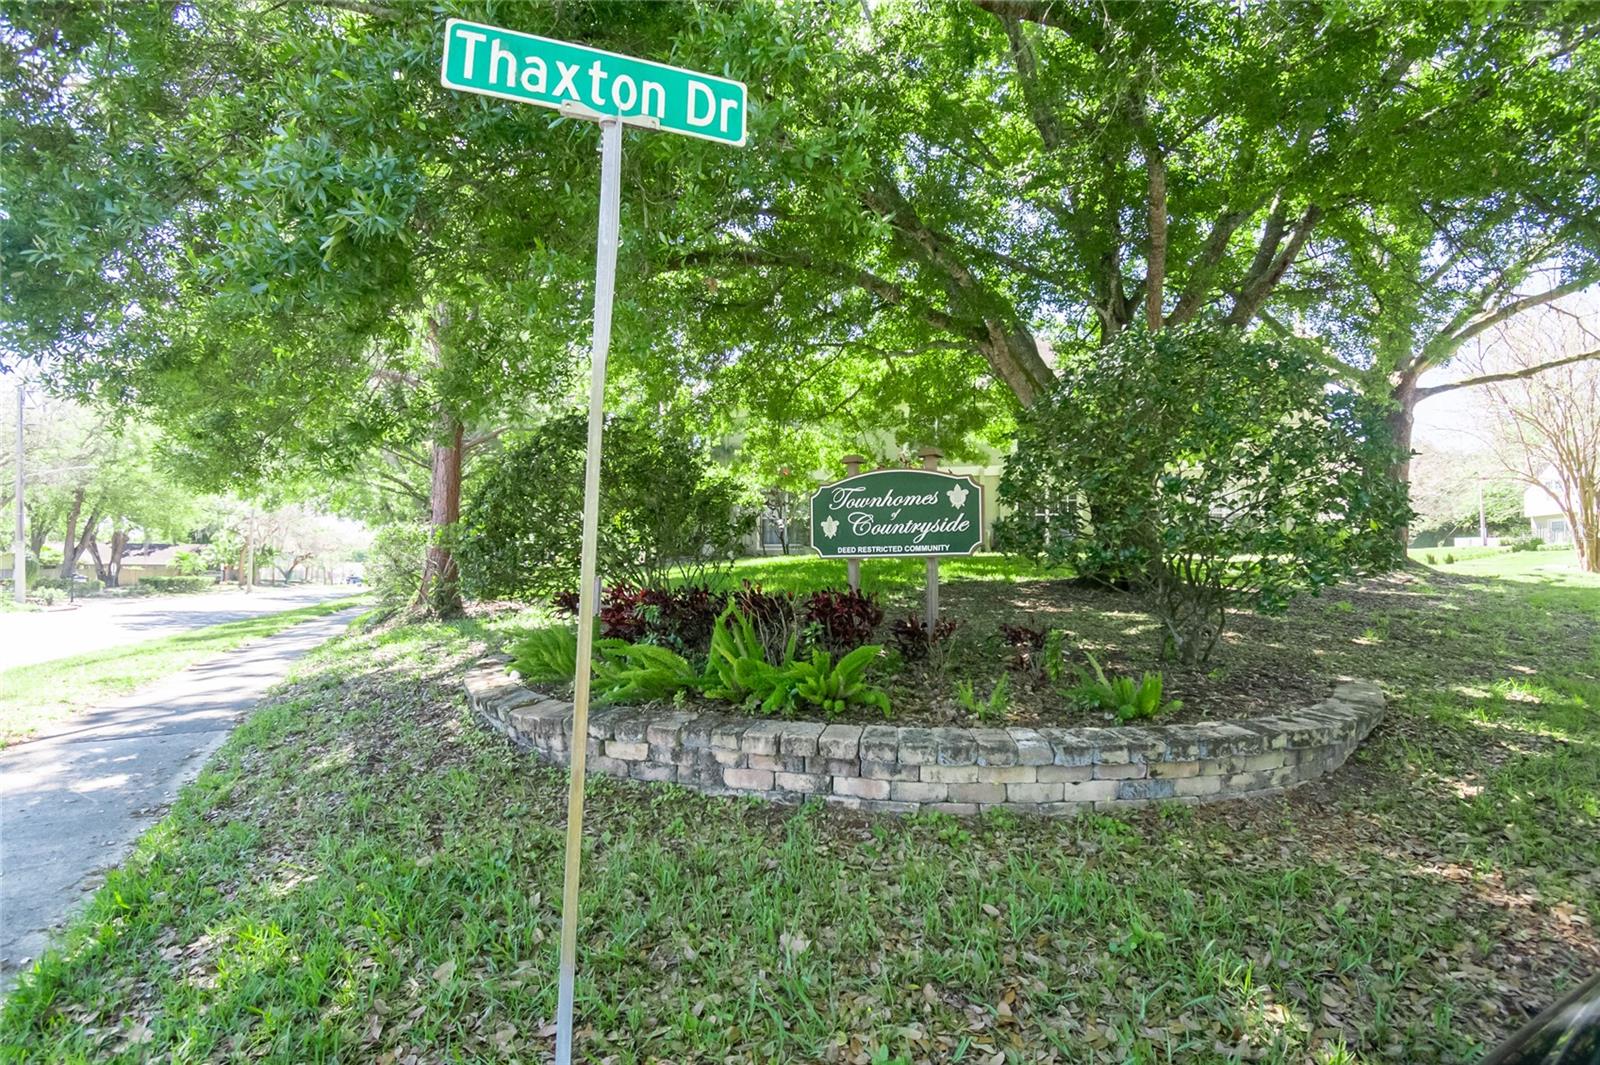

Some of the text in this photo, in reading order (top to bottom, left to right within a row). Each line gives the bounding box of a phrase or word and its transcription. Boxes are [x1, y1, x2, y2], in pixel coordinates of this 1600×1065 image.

[456, 29, 738, 133] Thaxton Dr
[829, 487, 939, 510] Townhomes
[890, 508, 902, 521] of
[848, 512, 970, 543] Countryside
[837, 544, 951, 554] DEED RESTRICTED COMMUNITY
